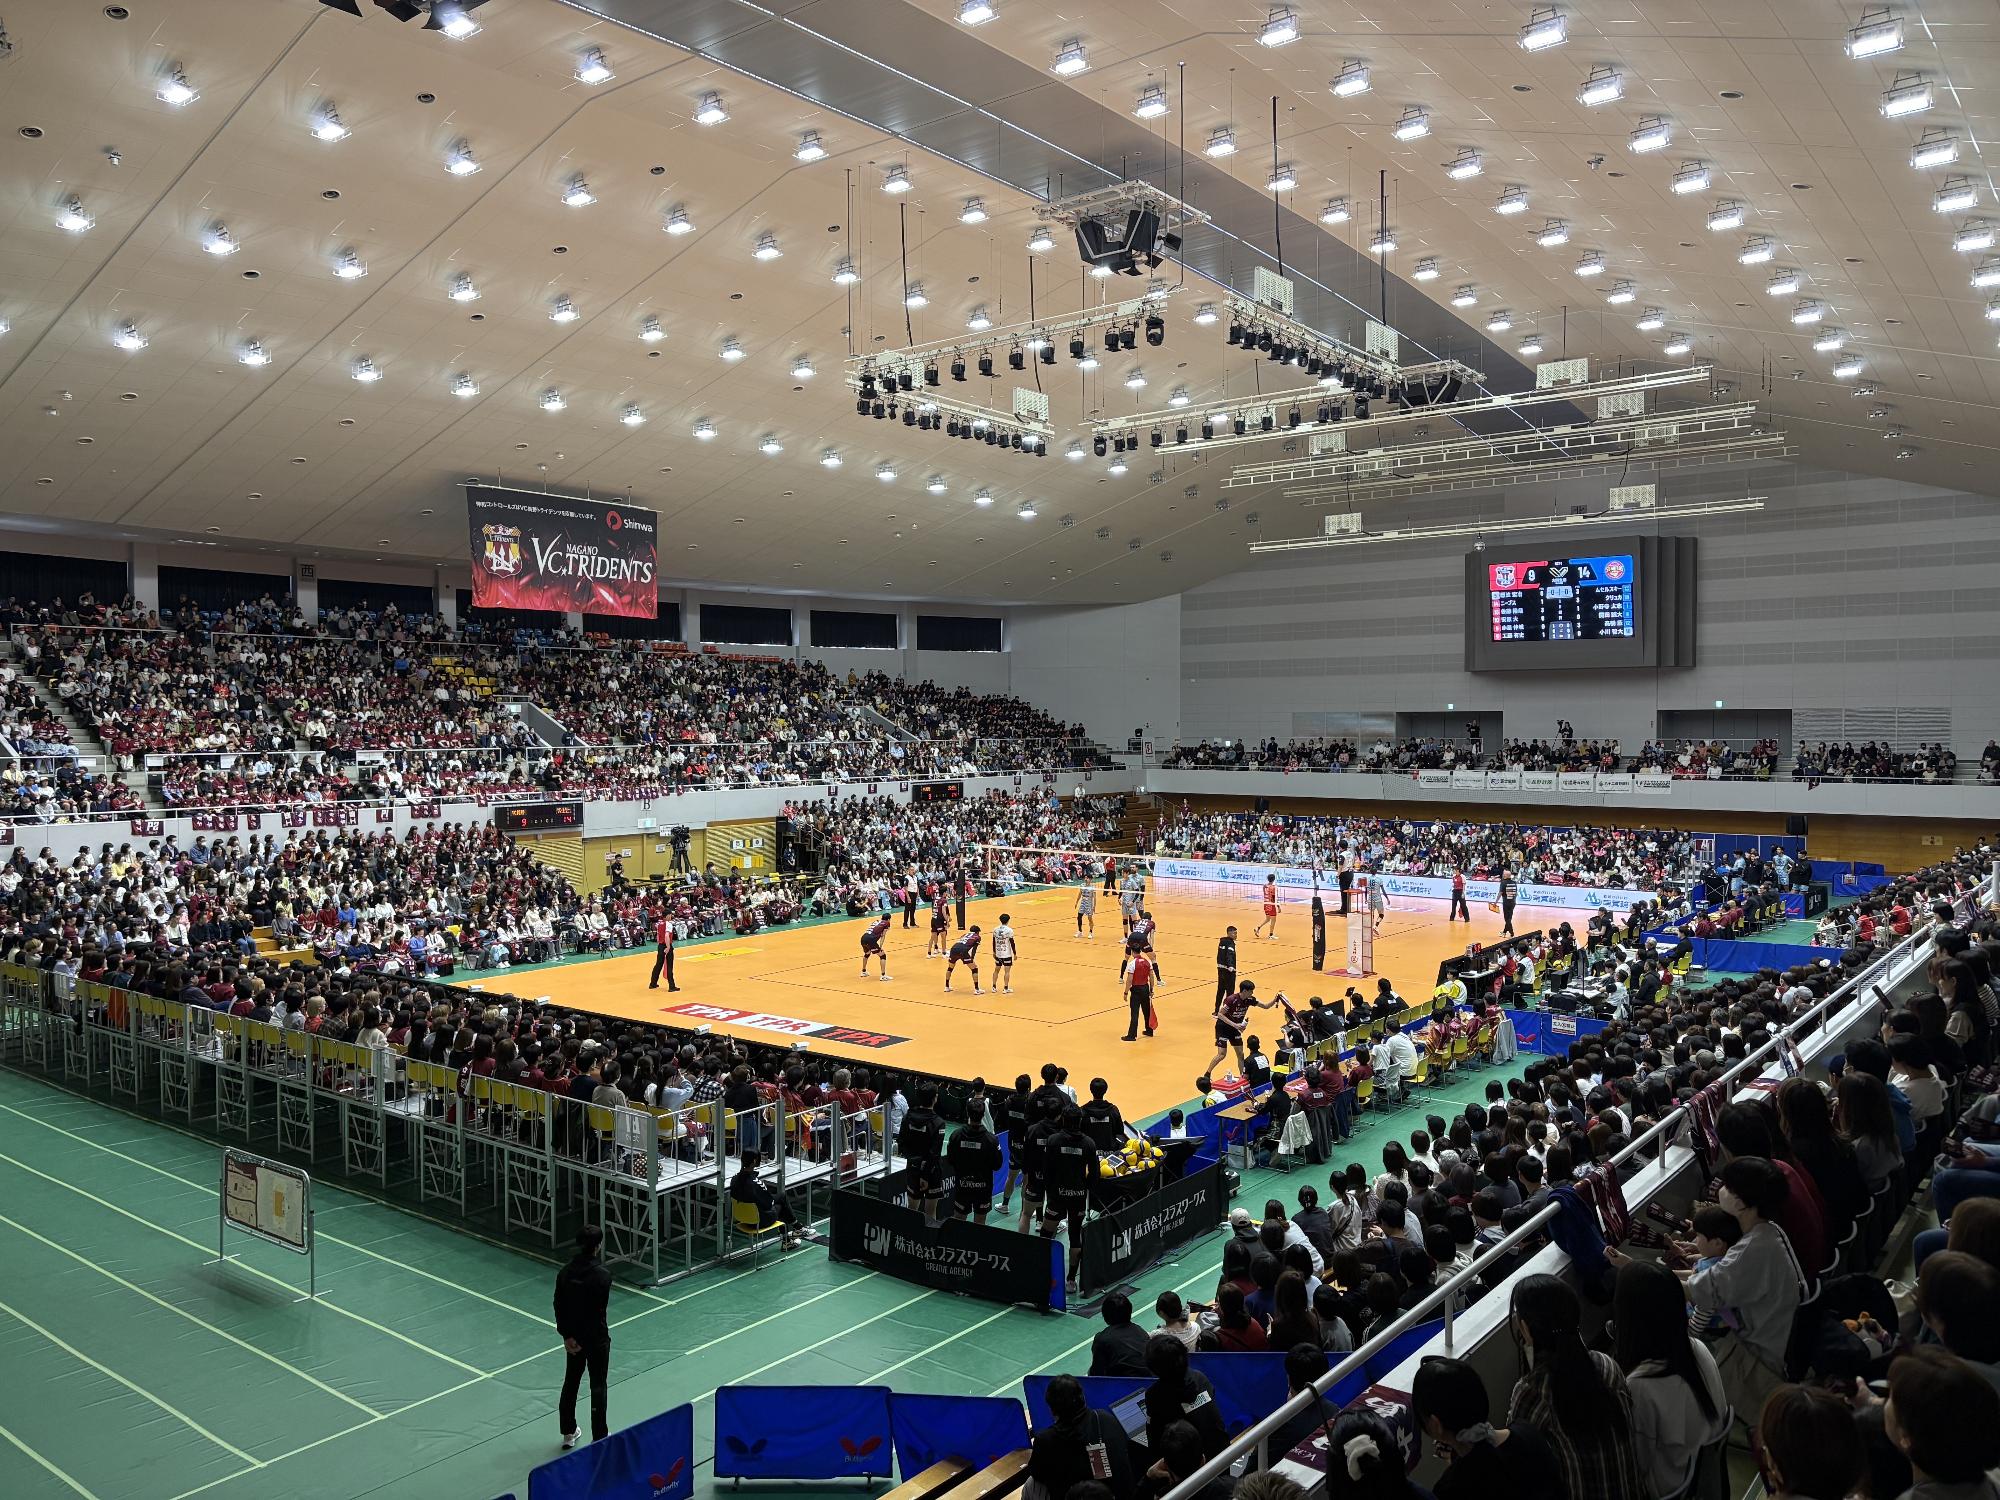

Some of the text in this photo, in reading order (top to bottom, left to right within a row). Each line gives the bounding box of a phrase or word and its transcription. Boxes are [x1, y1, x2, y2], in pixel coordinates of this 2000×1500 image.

[624, 518, 653, 533] Shinwa
[566, 543, 598, 556] NAGANO
[1528, 569, 1536, 581] 9
[1577, 566, 1591, 579] 14
[643, 799, 651, 810] B
[521, 818, 528, 827] 9
[677, 1004, 741, 1021] TPR
[748, 1016, 811, 1032] TPR
[822, 1028, 891, 1047] TPR
[894, 1234, 1011, 1273] 株式会社プラスワークス
[949, 1265, 974, 1279] AGENCY
[653, 1479, 681, 1498] Butterfly
